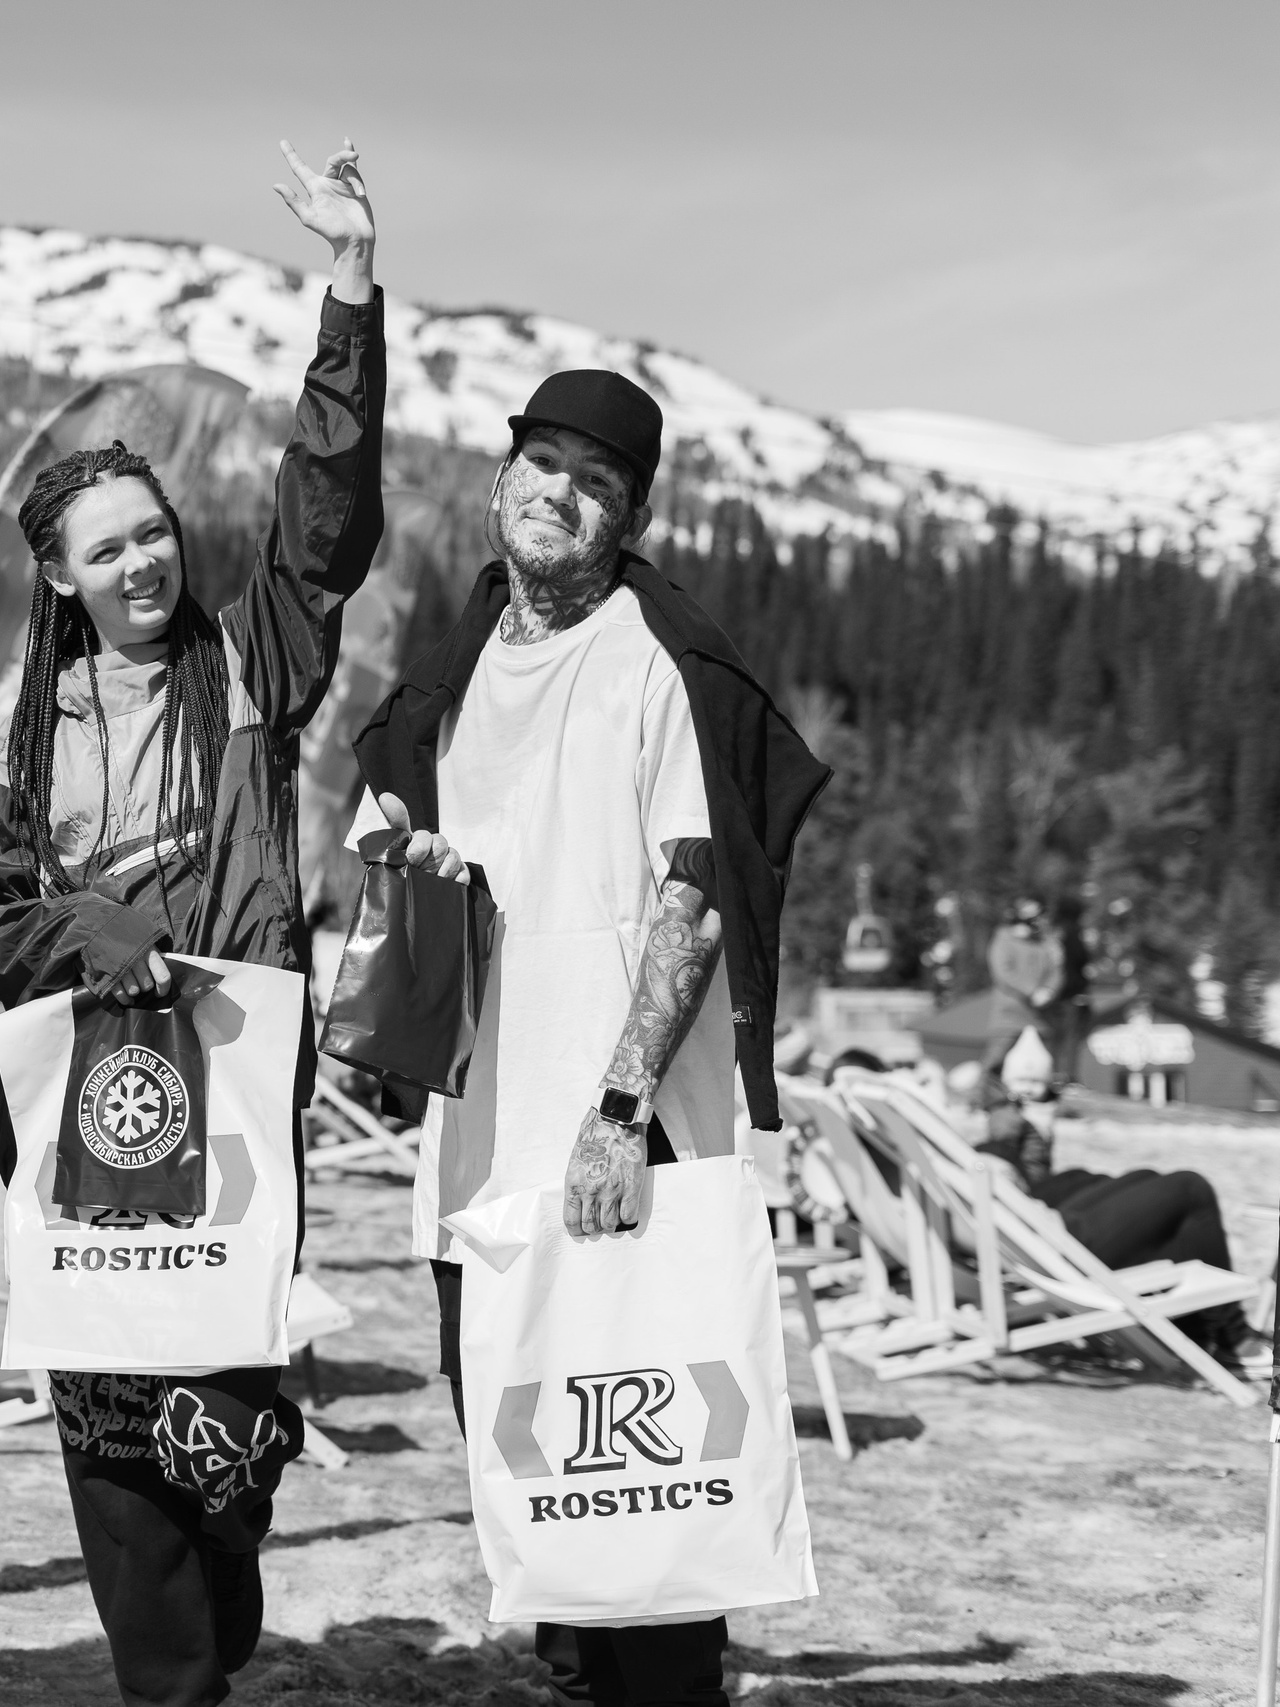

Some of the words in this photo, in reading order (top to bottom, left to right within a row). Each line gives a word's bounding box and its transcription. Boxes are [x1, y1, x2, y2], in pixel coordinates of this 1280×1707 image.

[132, 1050, 159, 1070] КЛУБ
[157, 1066, 184, 1106] СИБИРЬ
[81, 1112, 145, 1166] НОВОСИБИРСКАЯ
[147, 1122, 184, 1160] ОБЛАСТЬ
[52, 1242, 227, 1271] ROSTIC'S
[563, 1368, 683, 1476] R
[97, 1438, 147, 1459] YOUR
[528, 1478, 734, 1523] ROSTIC'S
